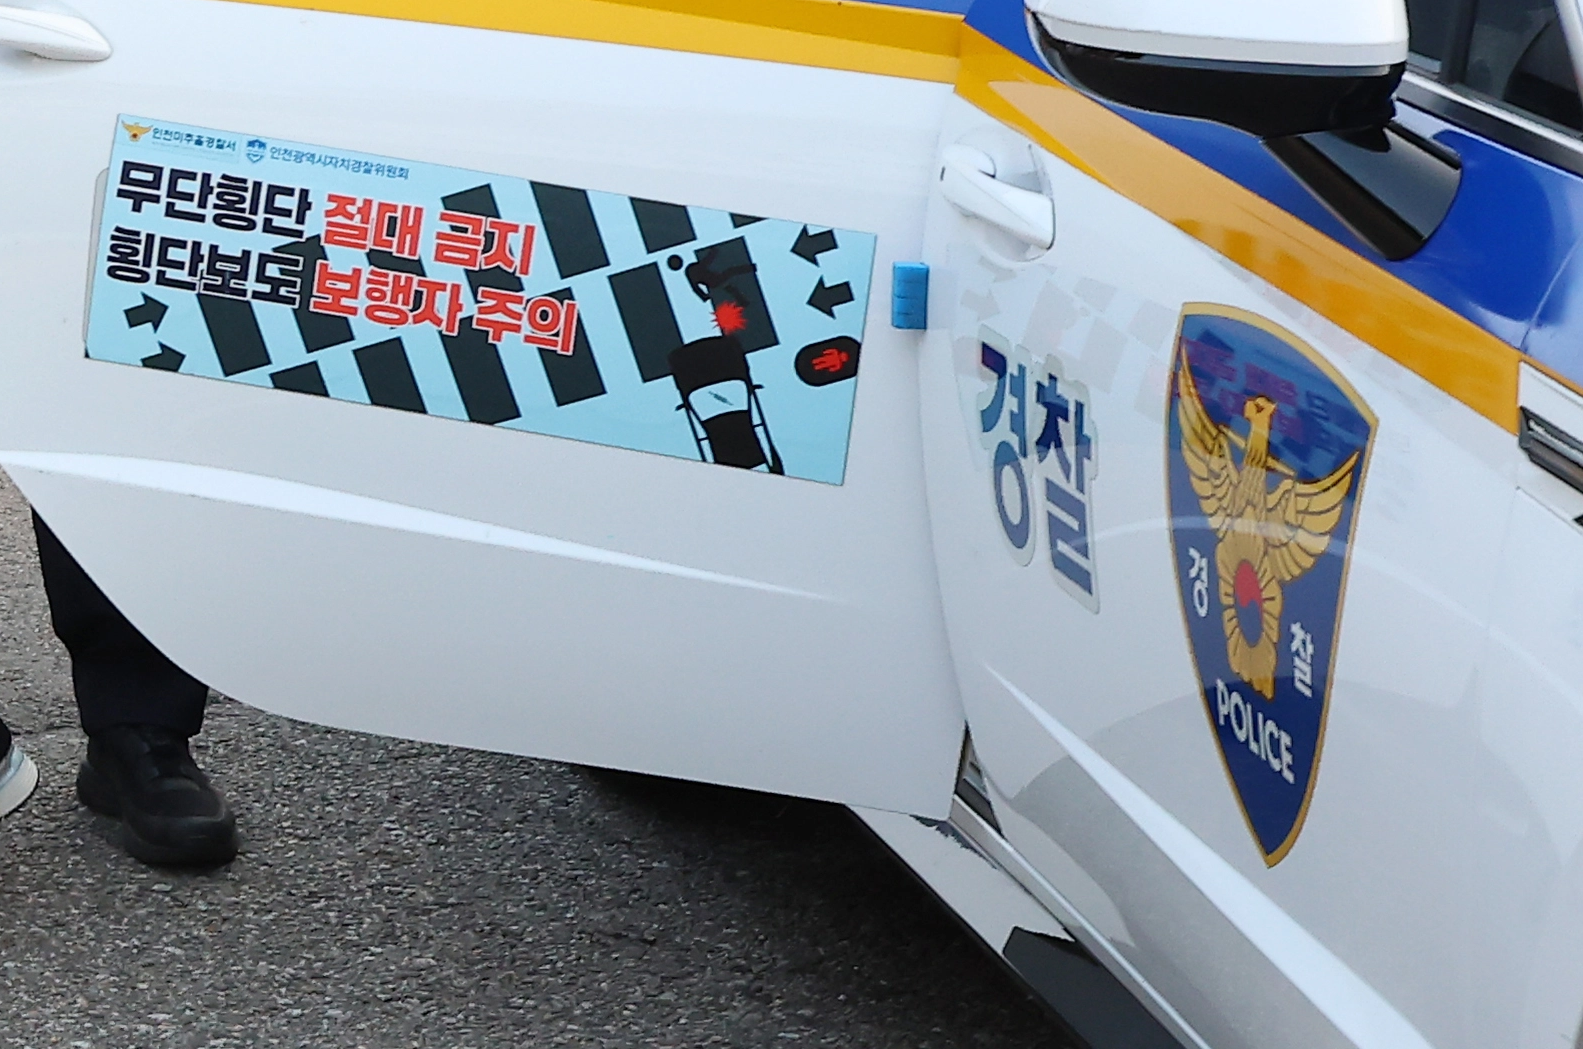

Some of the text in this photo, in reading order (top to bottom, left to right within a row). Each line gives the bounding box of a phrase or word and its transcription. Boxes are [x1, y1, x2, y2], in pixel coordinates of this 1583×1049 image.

[151, 126, 237, 152] 인천미추홀경찰서
[269, 145, 410, 181] 인천광역시자치경찰위원회
[115, 160, 536, 277] 무단횡단 절대 금지
[105, 225, 578, 355] 횡단보도 보행자 주의
[980, 341, 1094, 596] 경찰
[1216, 678, 1295, 785] POLICE
